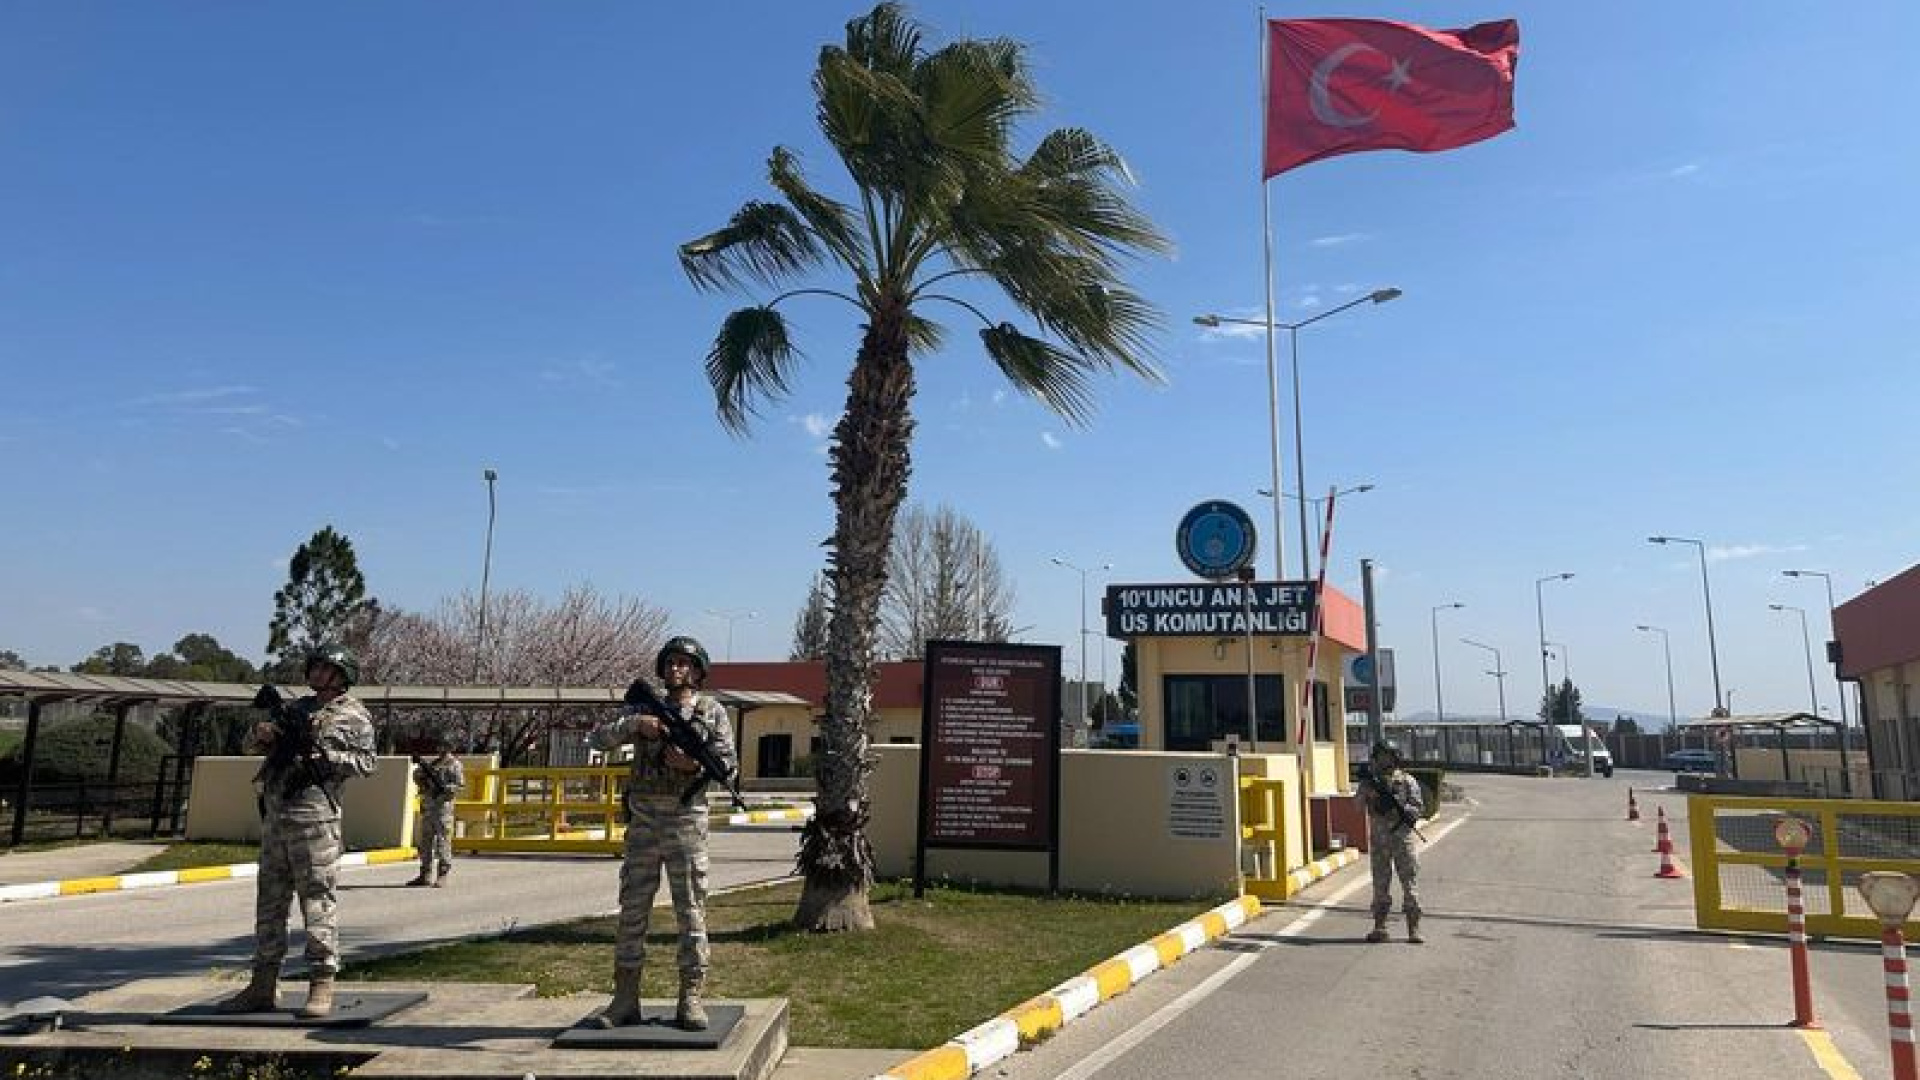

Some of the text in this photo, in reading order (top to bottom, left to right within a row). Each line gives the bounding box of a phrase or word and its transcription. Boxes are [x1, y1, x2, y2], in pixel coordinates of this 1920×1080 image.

[1211, 587, 1258, 606] ANA
[1265, 586, 1307, 606] JET
[1121, 607, 1307, 632] ÜS KOMUTANLIĞI
